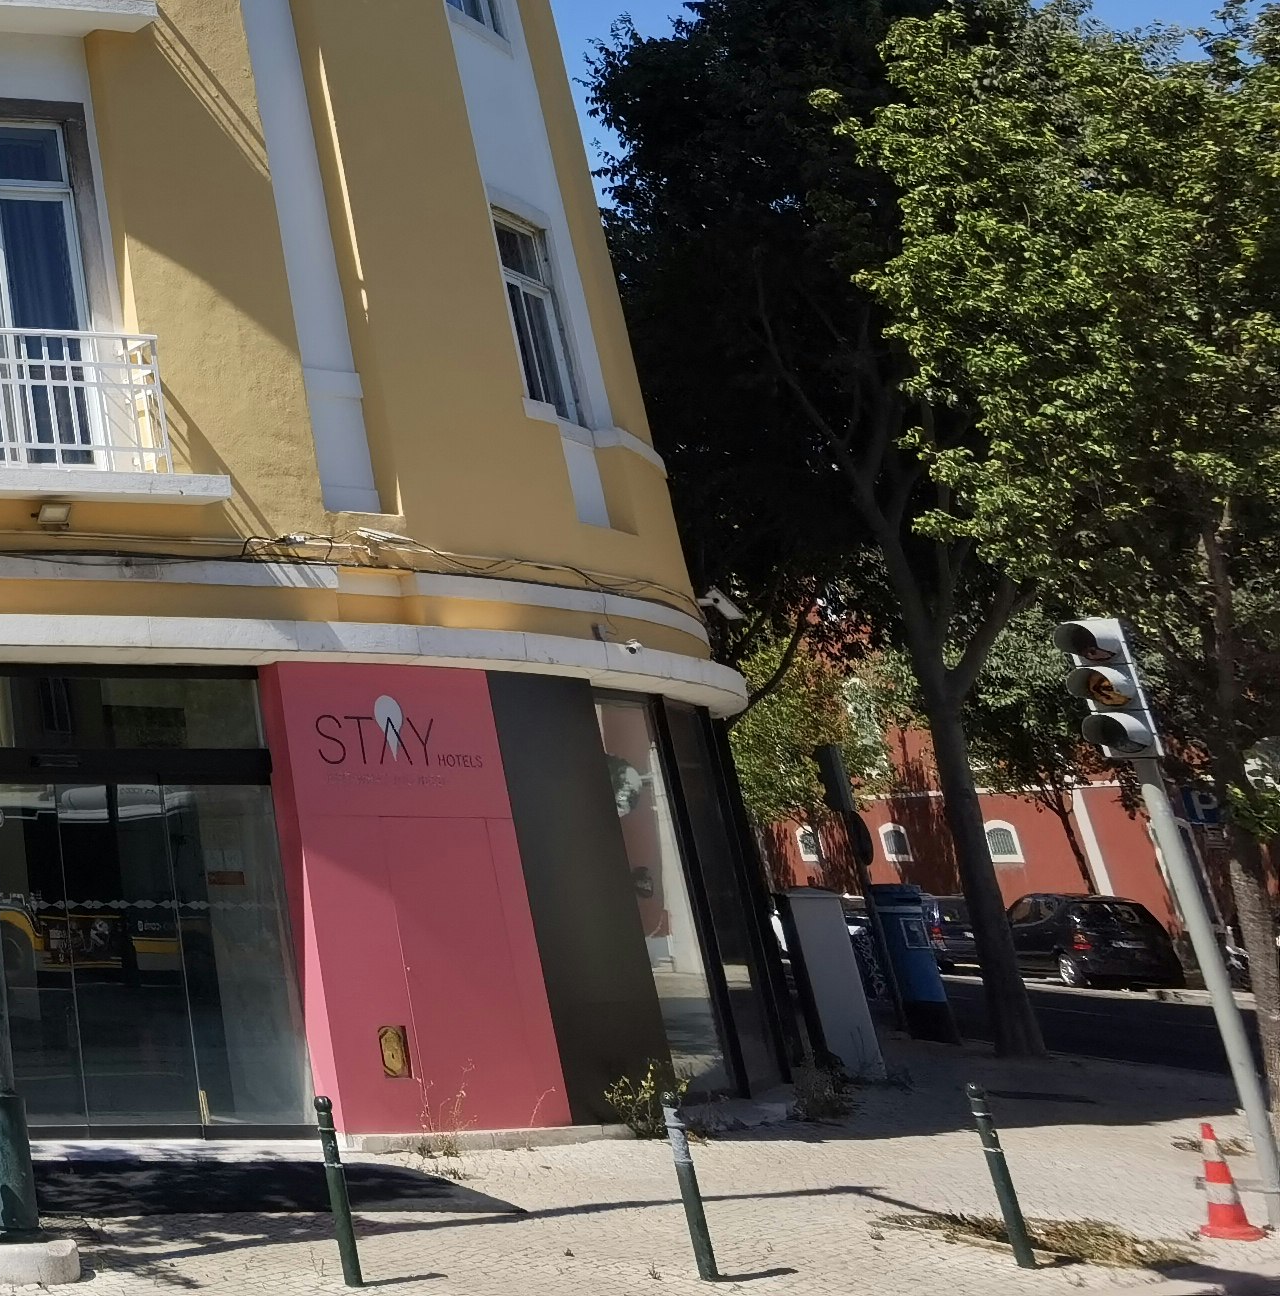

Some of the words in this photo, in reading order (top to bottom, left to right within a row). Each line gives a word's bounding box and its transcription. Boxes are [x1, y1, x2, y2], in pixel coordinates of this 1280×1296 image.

[315, 714, 434, 766] STAY
[437, 753, 483, 768] HOTELS
[1190, 790, 1219, 821] P
